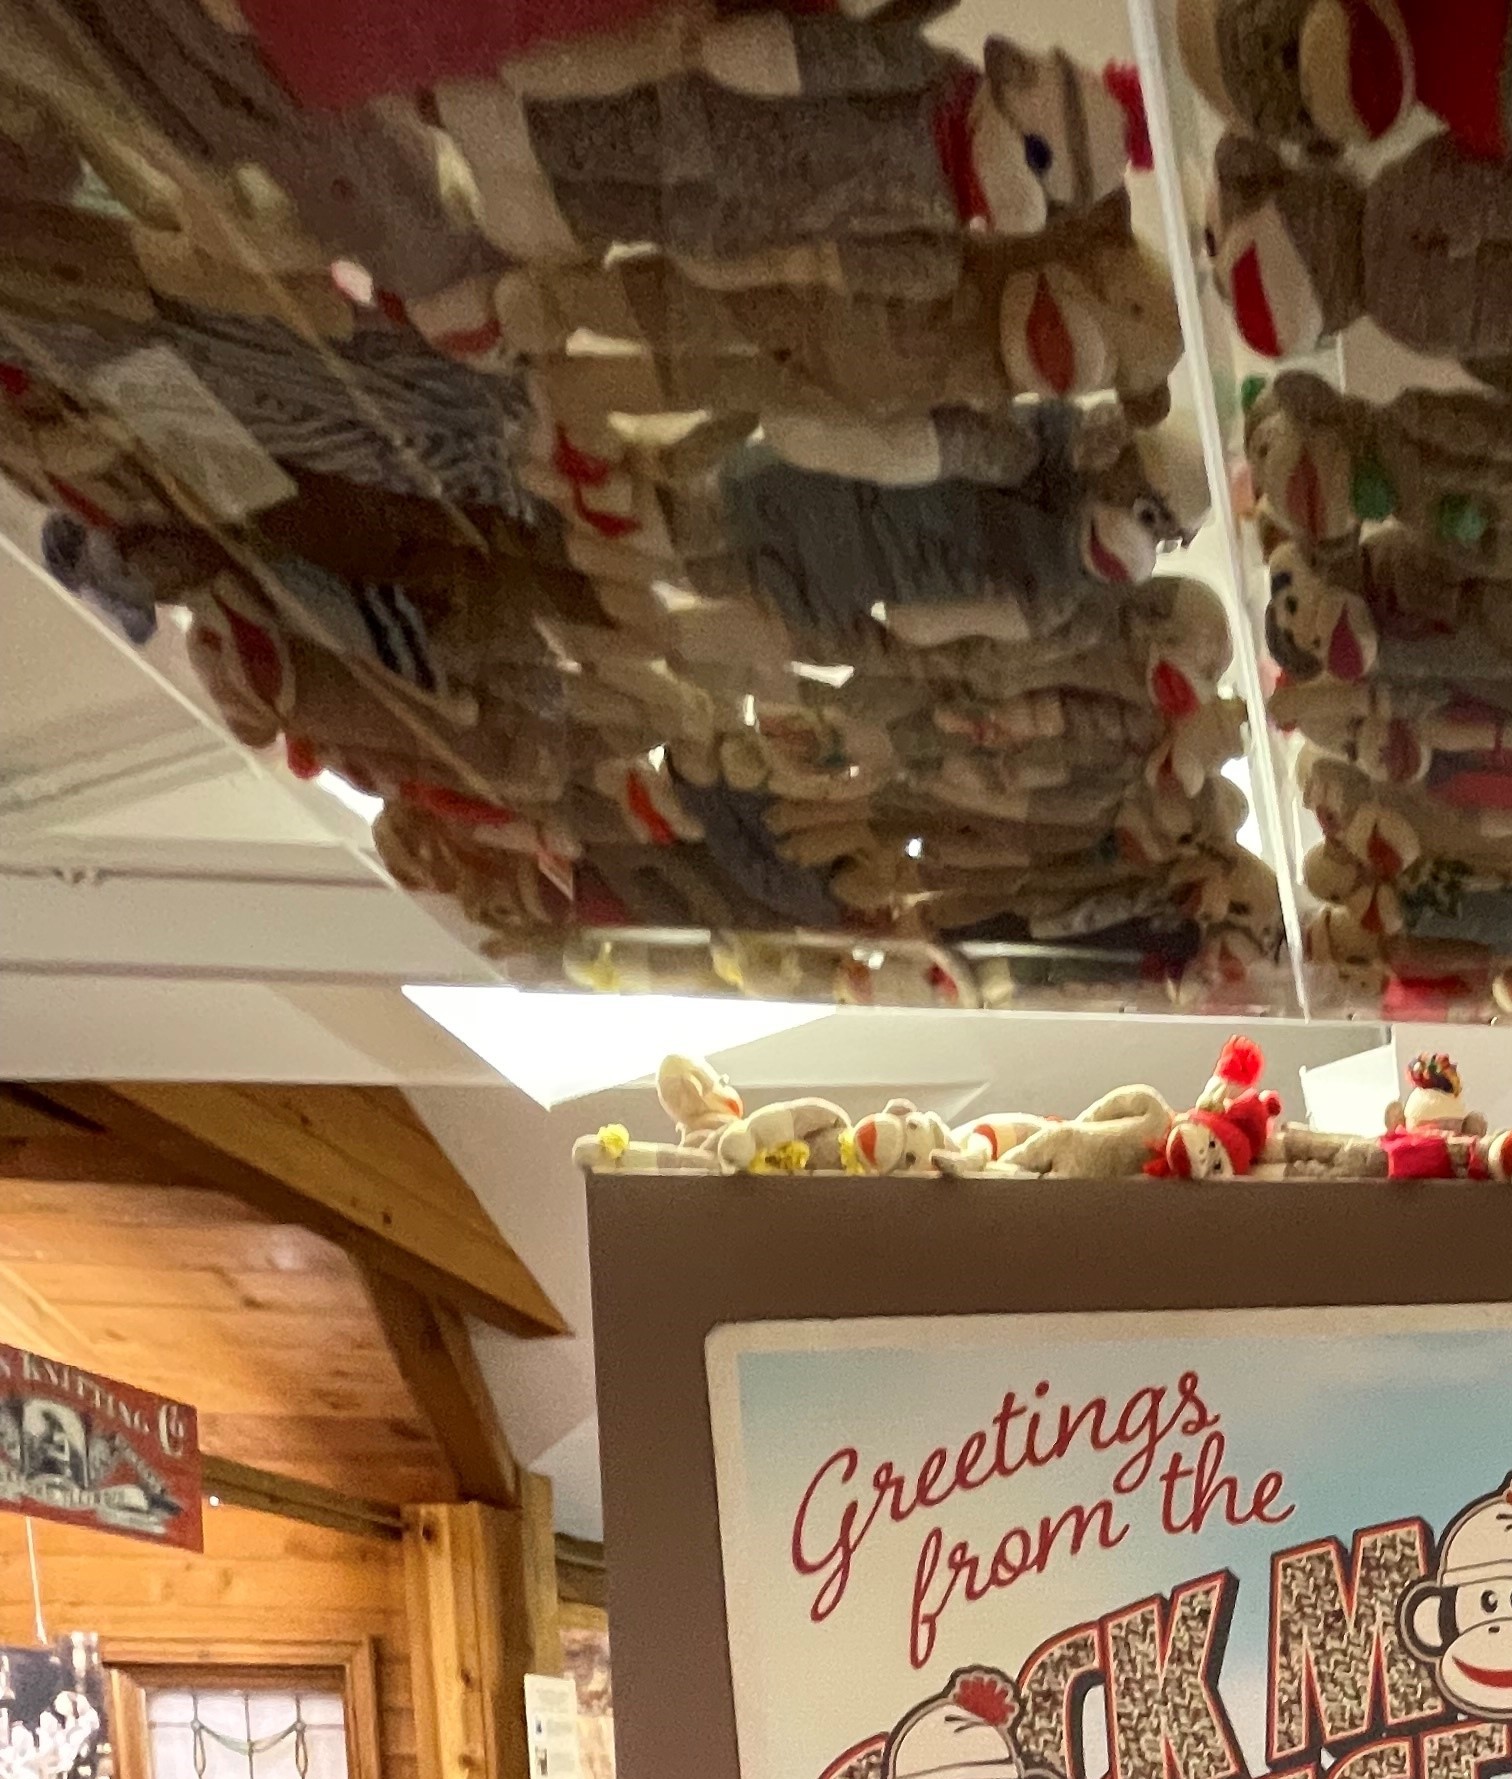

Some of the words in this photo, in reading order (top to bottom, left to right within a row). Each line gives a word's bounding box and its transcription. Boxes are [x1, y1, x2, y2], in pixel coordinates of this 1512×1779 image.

[791, 1369, 1220, 1623] Greetings
[909, 1491, 1131, 1670] from
[1159, 1431, 1296, 1534] the
